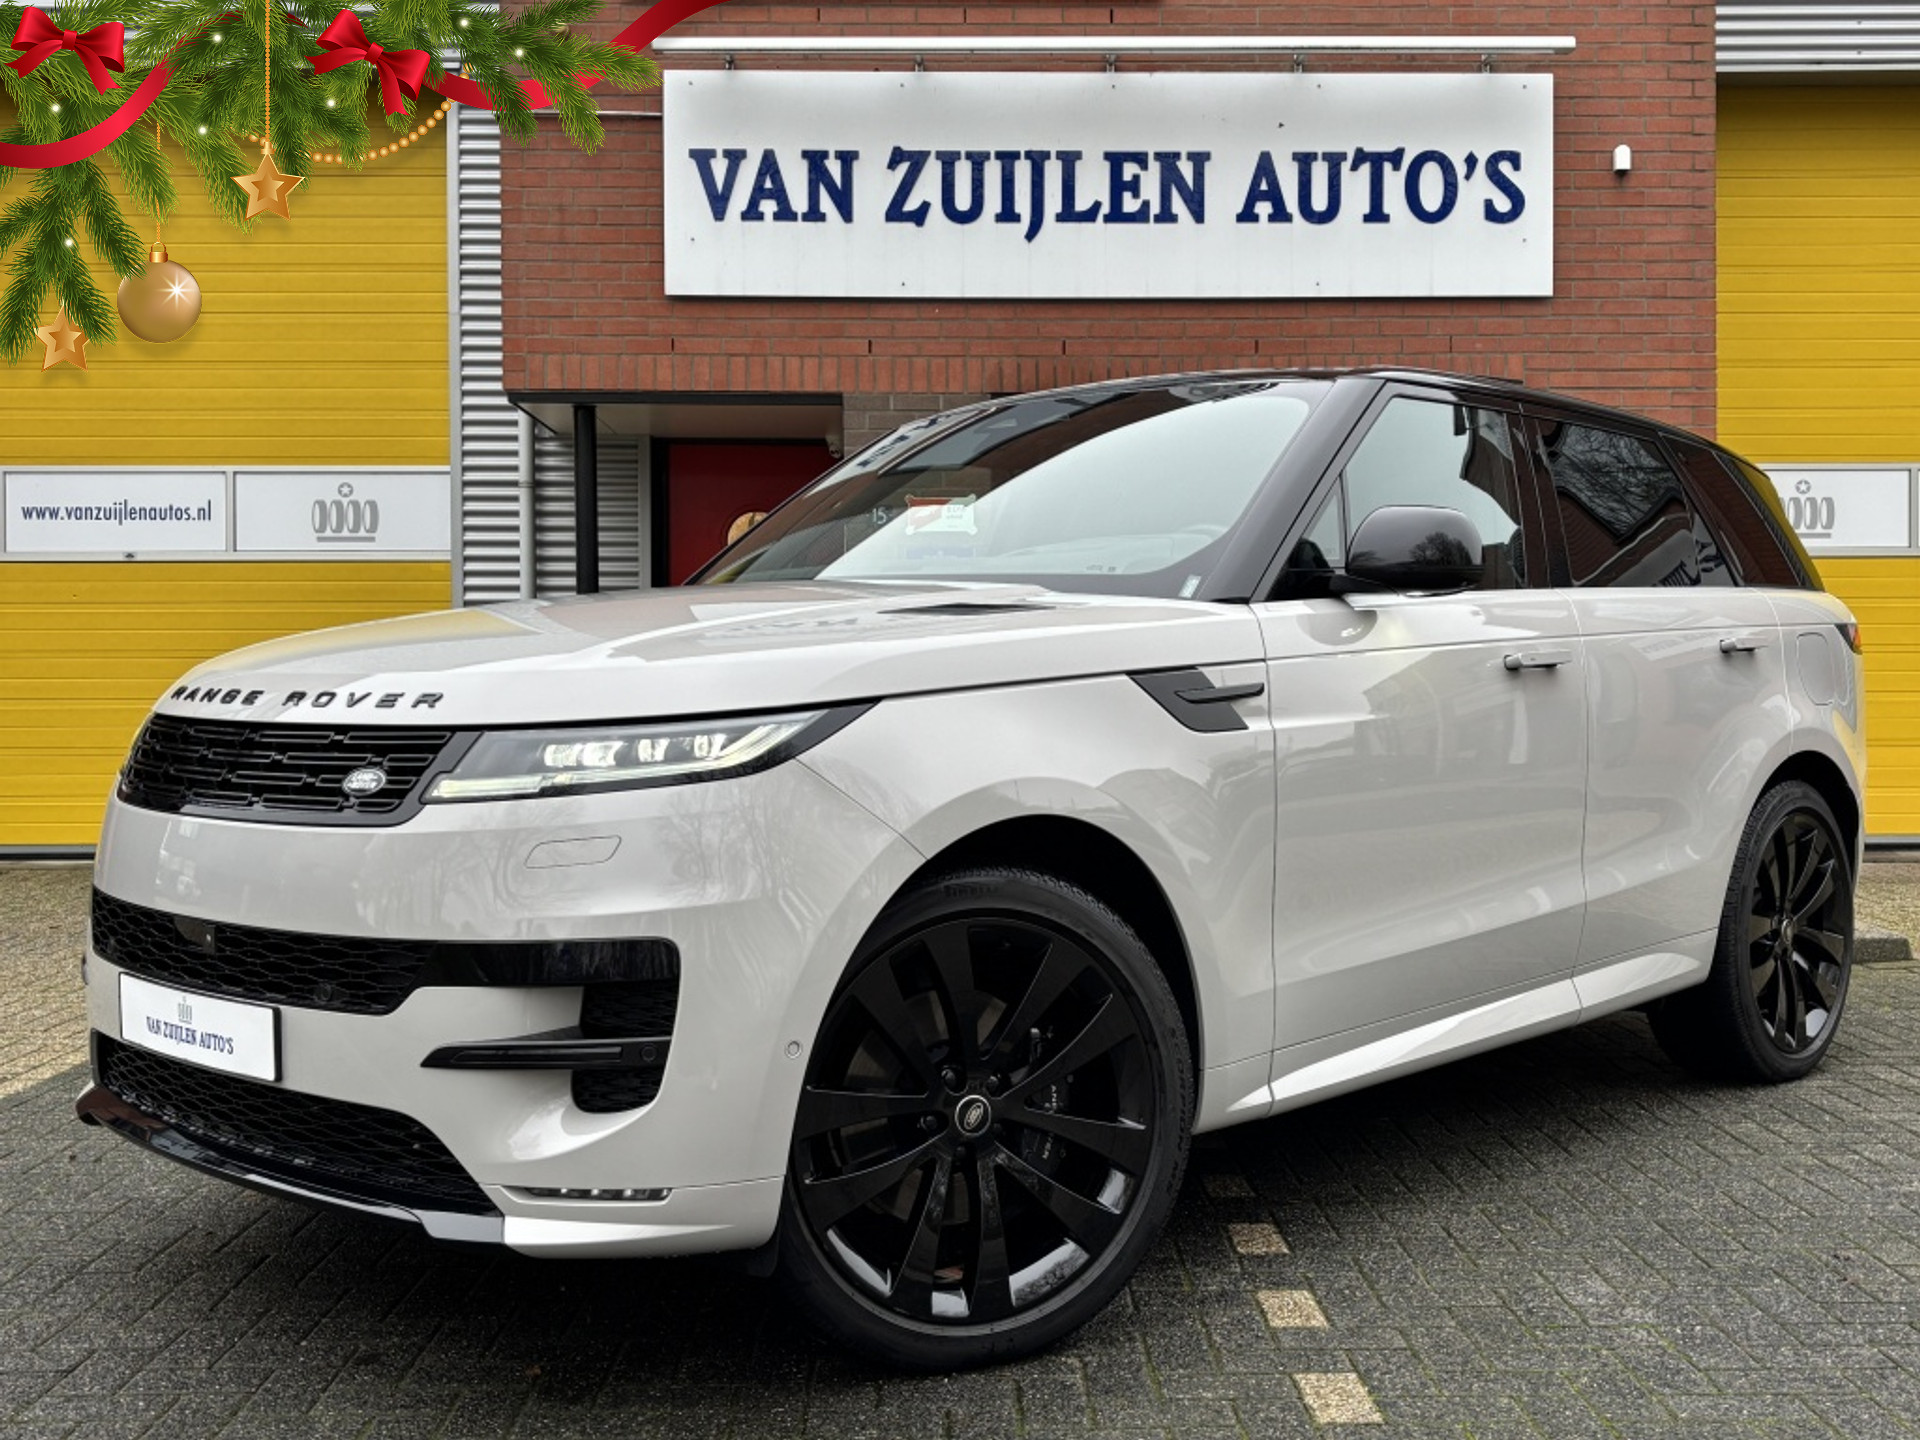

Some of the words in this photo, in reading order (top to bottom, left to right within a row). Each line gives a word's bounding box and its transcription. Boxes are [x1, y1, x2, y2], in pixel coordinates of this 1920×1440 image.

[688, 148, 860, 224] VAN
[884, 146, 1212, 243] ZUIJLEN
[1235, 147, 1526, 225] AUTO'S
[21, 499, 212, 526] www.vanzuijlenautos.nl
[170, 686, 265, 706] RANGE
[281, 691, 444, 709] ROVER
